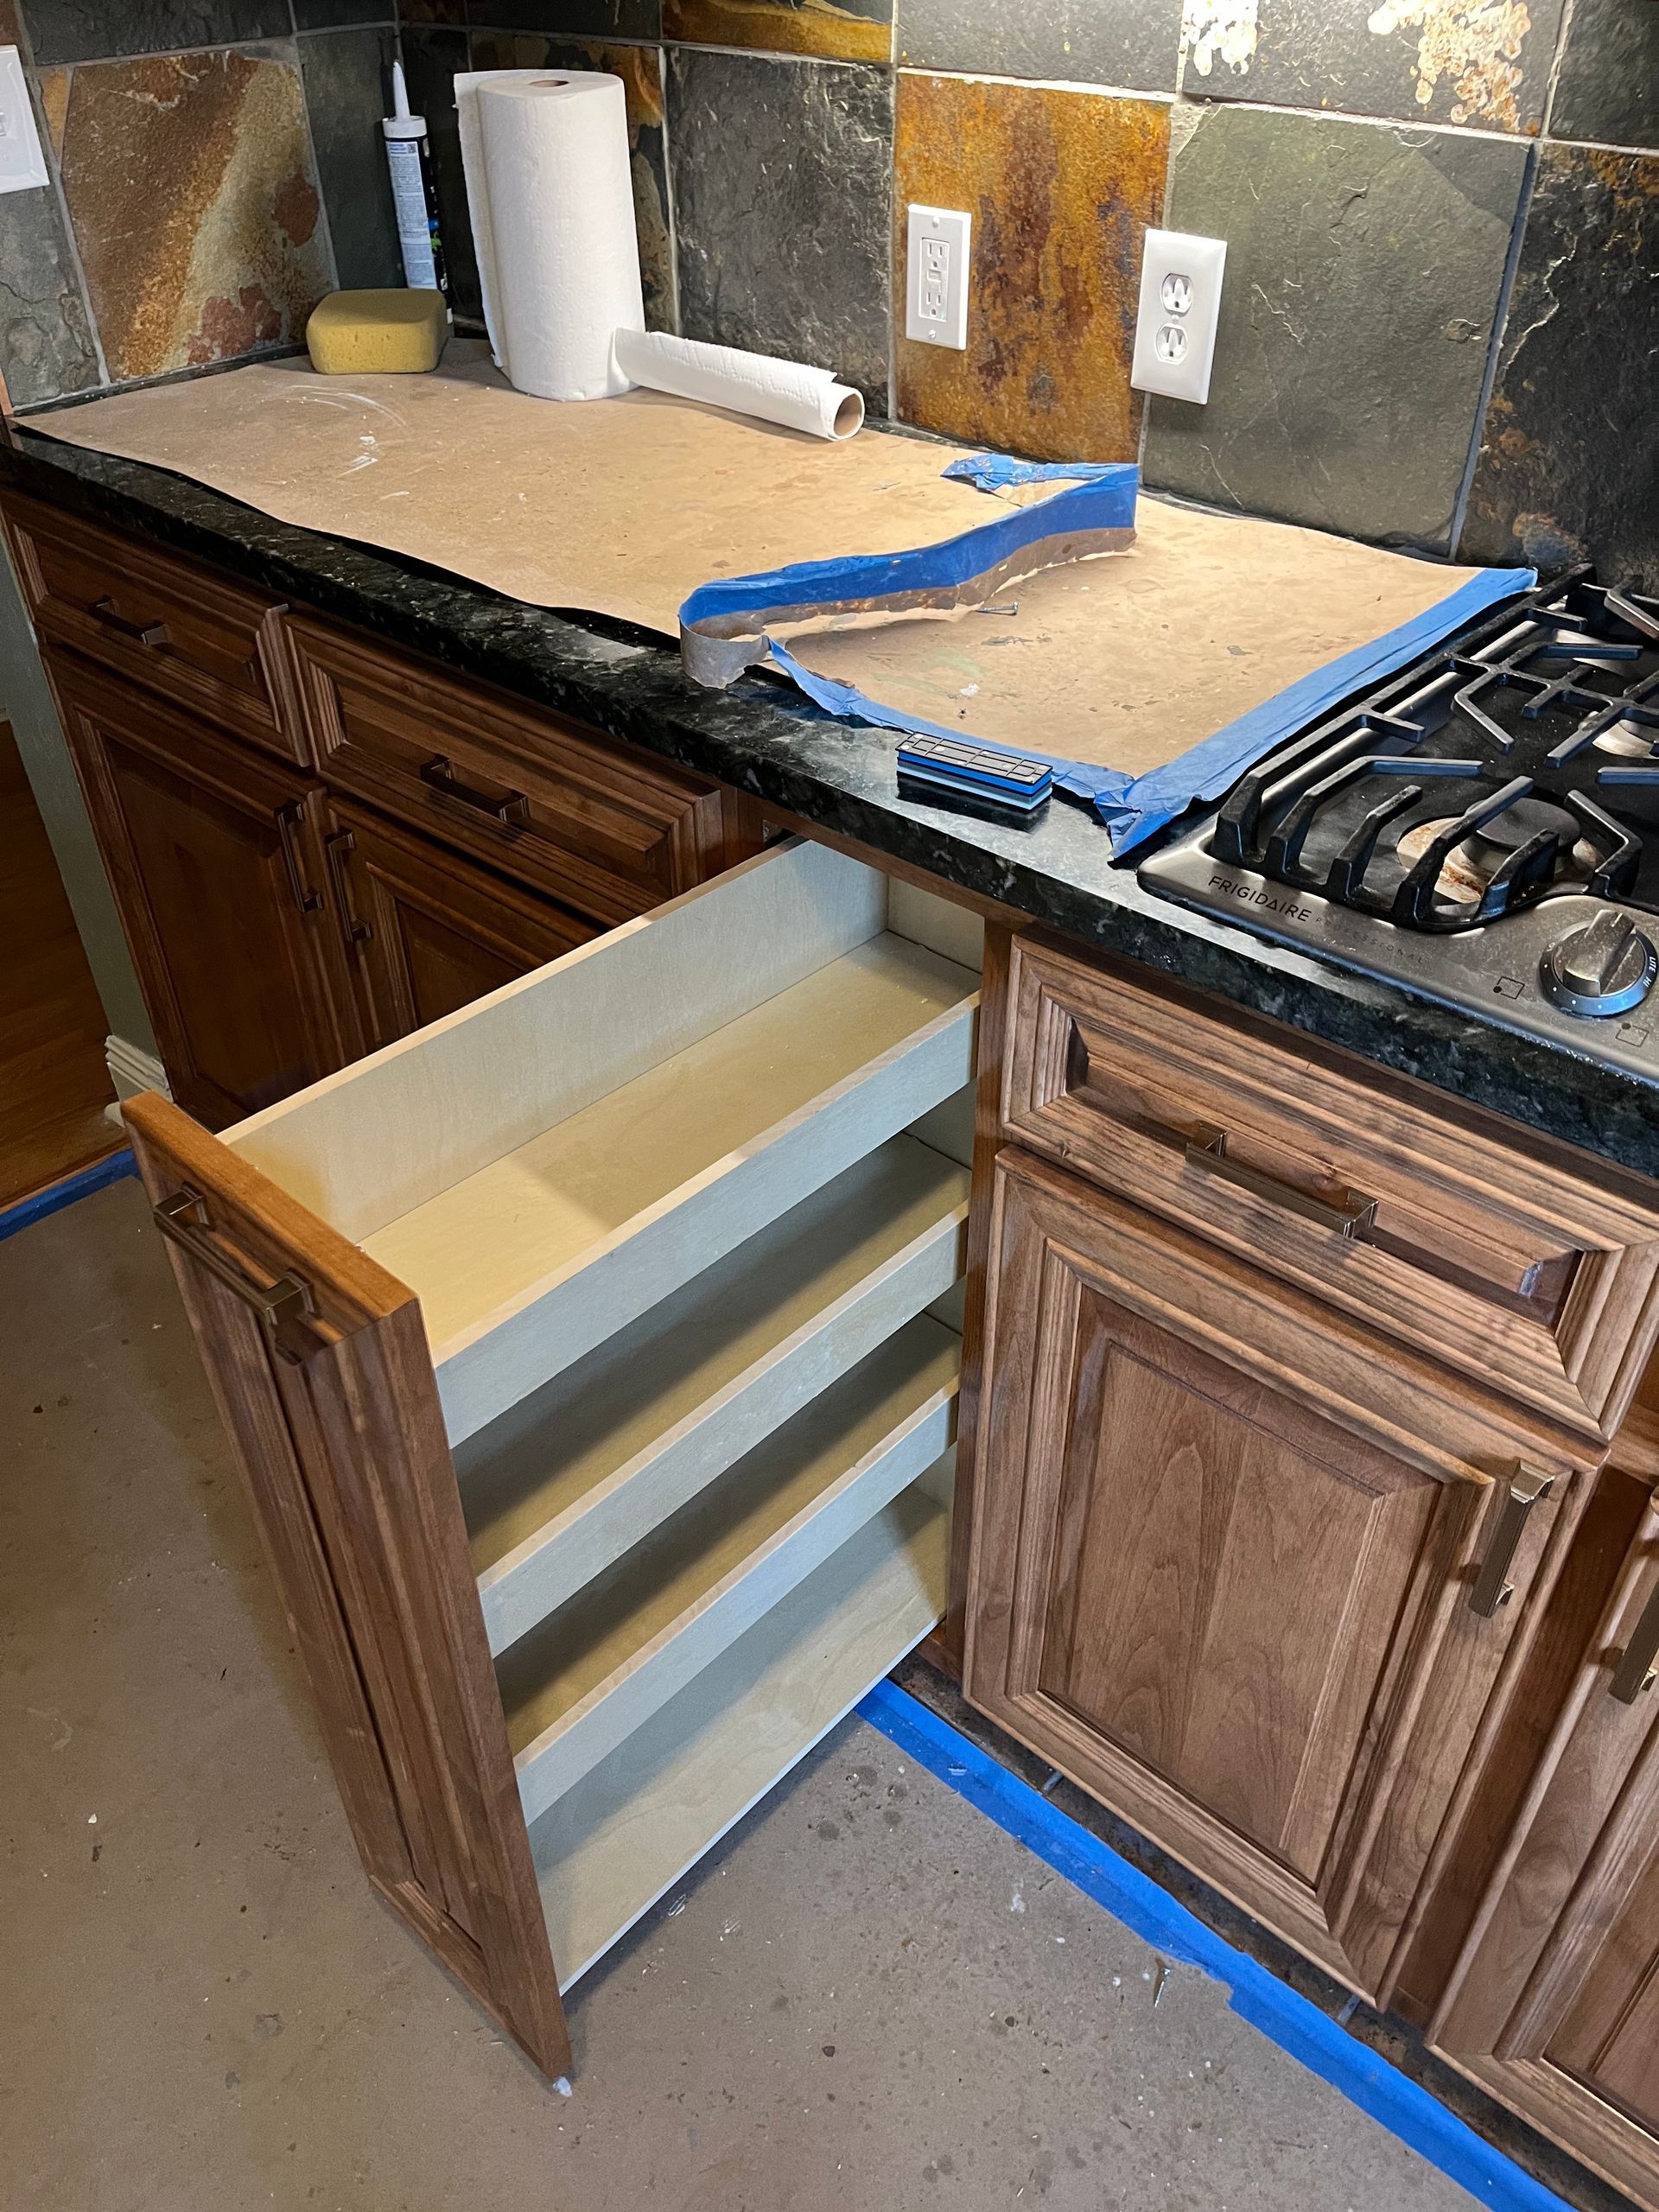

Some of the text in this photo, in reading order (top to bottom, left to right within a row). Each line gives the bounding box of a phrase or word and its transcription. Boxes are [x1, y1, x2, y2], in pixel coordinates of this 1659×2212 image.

[1208, 875, 1312, 922] FRIGIDAIRE
[1648, 956, 1656, 973] LITE
[1643, 976, 1652, 988] HI
